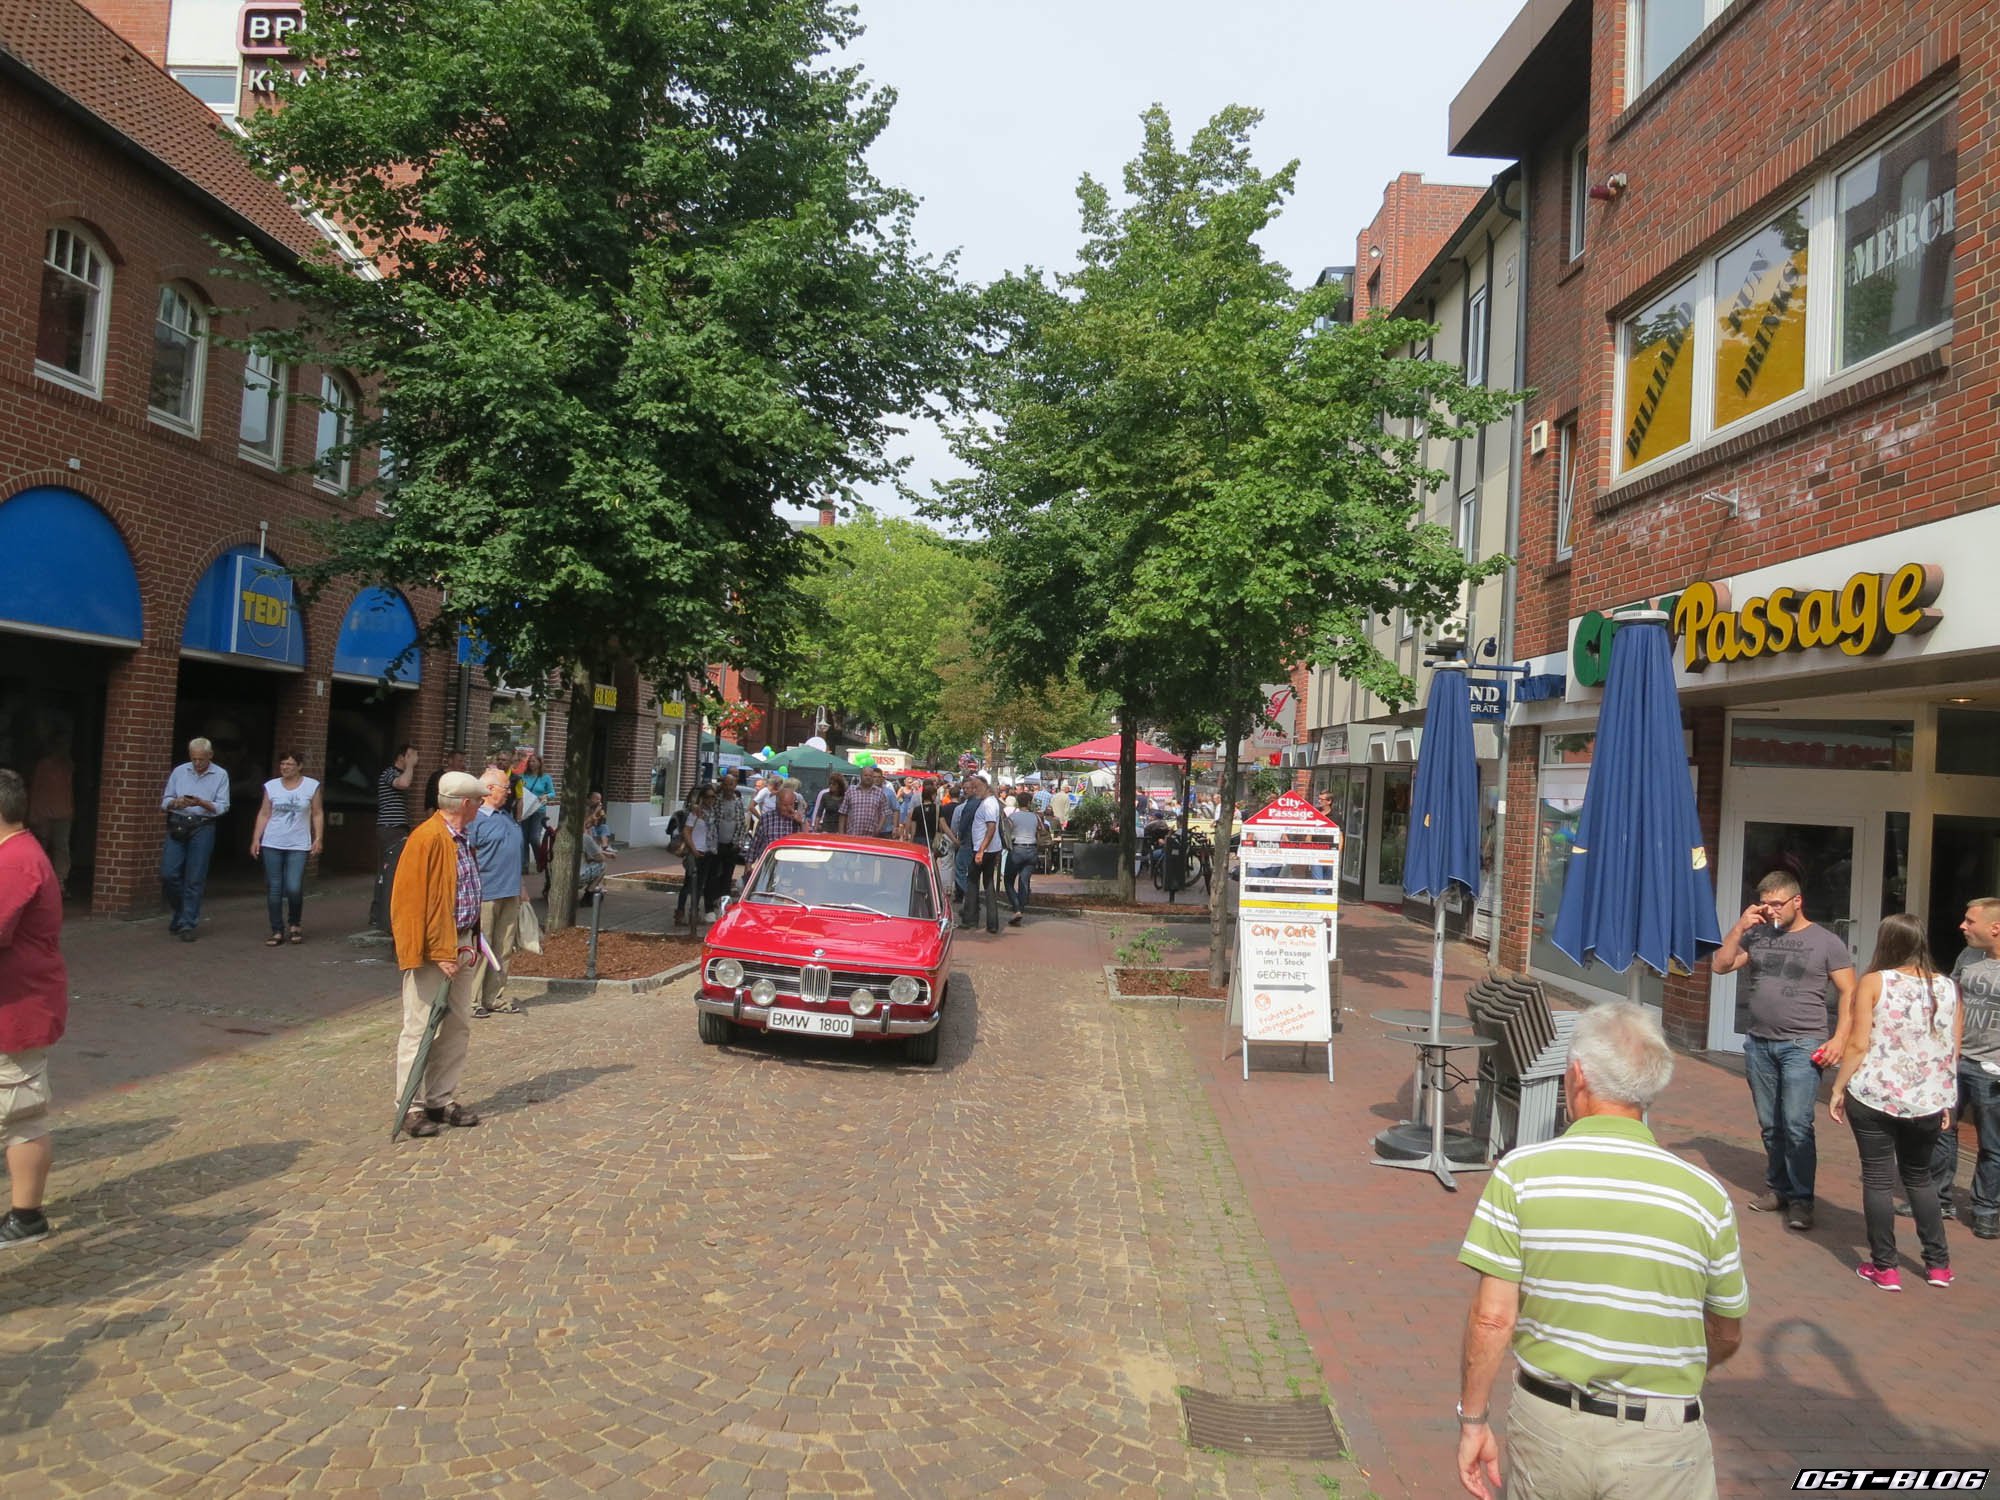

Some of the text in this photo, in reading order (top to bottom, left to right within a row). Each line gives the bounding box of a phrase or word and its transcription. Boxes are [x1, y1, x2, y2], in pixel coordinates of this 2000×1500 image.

[1728, 249, 1769, 333] FUN
[1736, 258, 1799, 398] DRINKS
[242, 591, 287, 628] TEDi
[1674, 562, 1930, 673] Passage
[1466, 685, 1500, 702] ND
[1470, 702, 1501, 714] ERÄTE
[1277, 797, 1305, 809] City-
[1268, 808, 1314, 819] Passage
[1251, 924, 1279, 940] City
[1265, 948, 1277, 956] der
[1280, 949, 1312, 958] Passage
[1284, 958, 1305, 966] Stock
[1257, 969, 1308, 980] GEÖFFNET
[772, 1012, 849, 1033] BMW 1800
